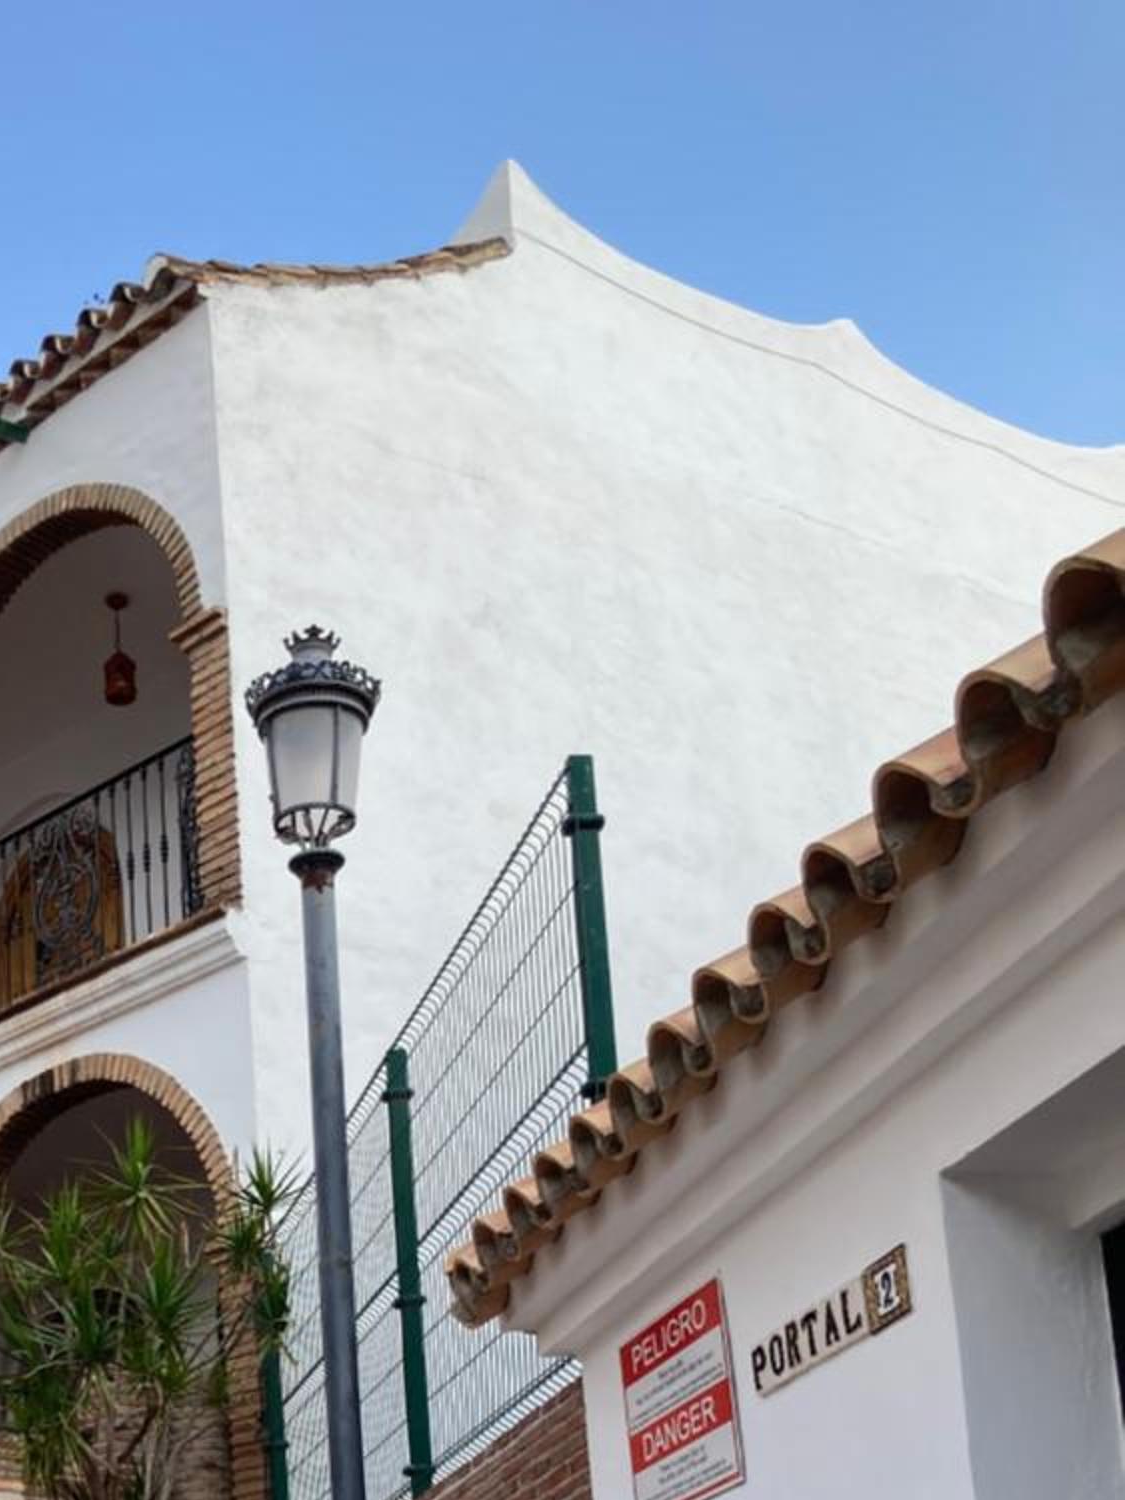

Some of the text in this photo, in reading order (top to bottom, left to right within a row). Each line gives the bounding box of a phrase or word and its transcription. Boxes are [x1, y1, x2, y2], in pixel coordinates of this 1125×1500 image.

[631, 1299, 706, 1375] PELIGRO
[751, 1289, 863, 1391] PORTAL
[880, 1271, 894, 1308] 2
[642, 1396, 716, 1462] DANGER
